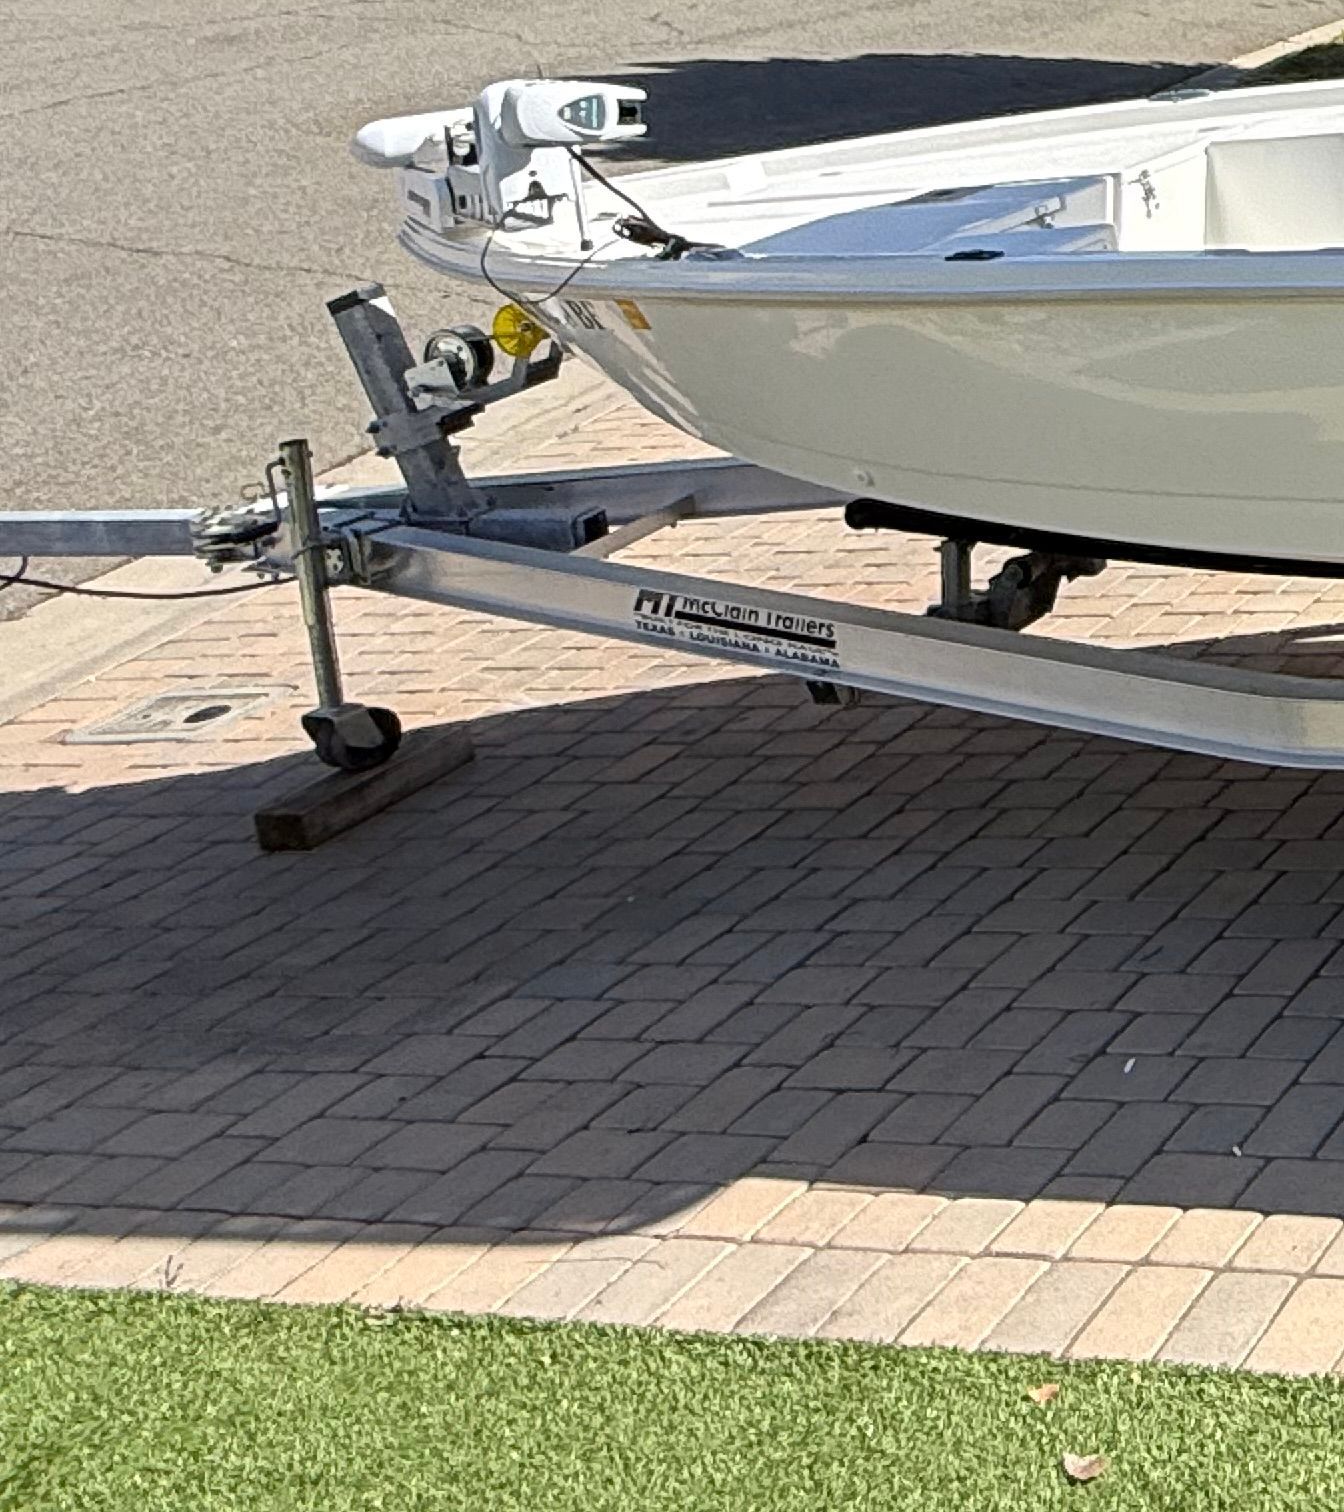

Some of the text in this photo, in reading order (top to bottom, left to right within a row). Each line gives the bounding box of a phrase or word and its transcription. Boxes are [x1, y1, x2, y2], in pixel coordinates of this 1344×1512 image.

[635, 618, 676, 636] TEXAS
[689, 630, 760, 654] LOUISIANA
[774, 646, 840, 668] ALABAMA
[765, 611, 835, 638] Trailers
